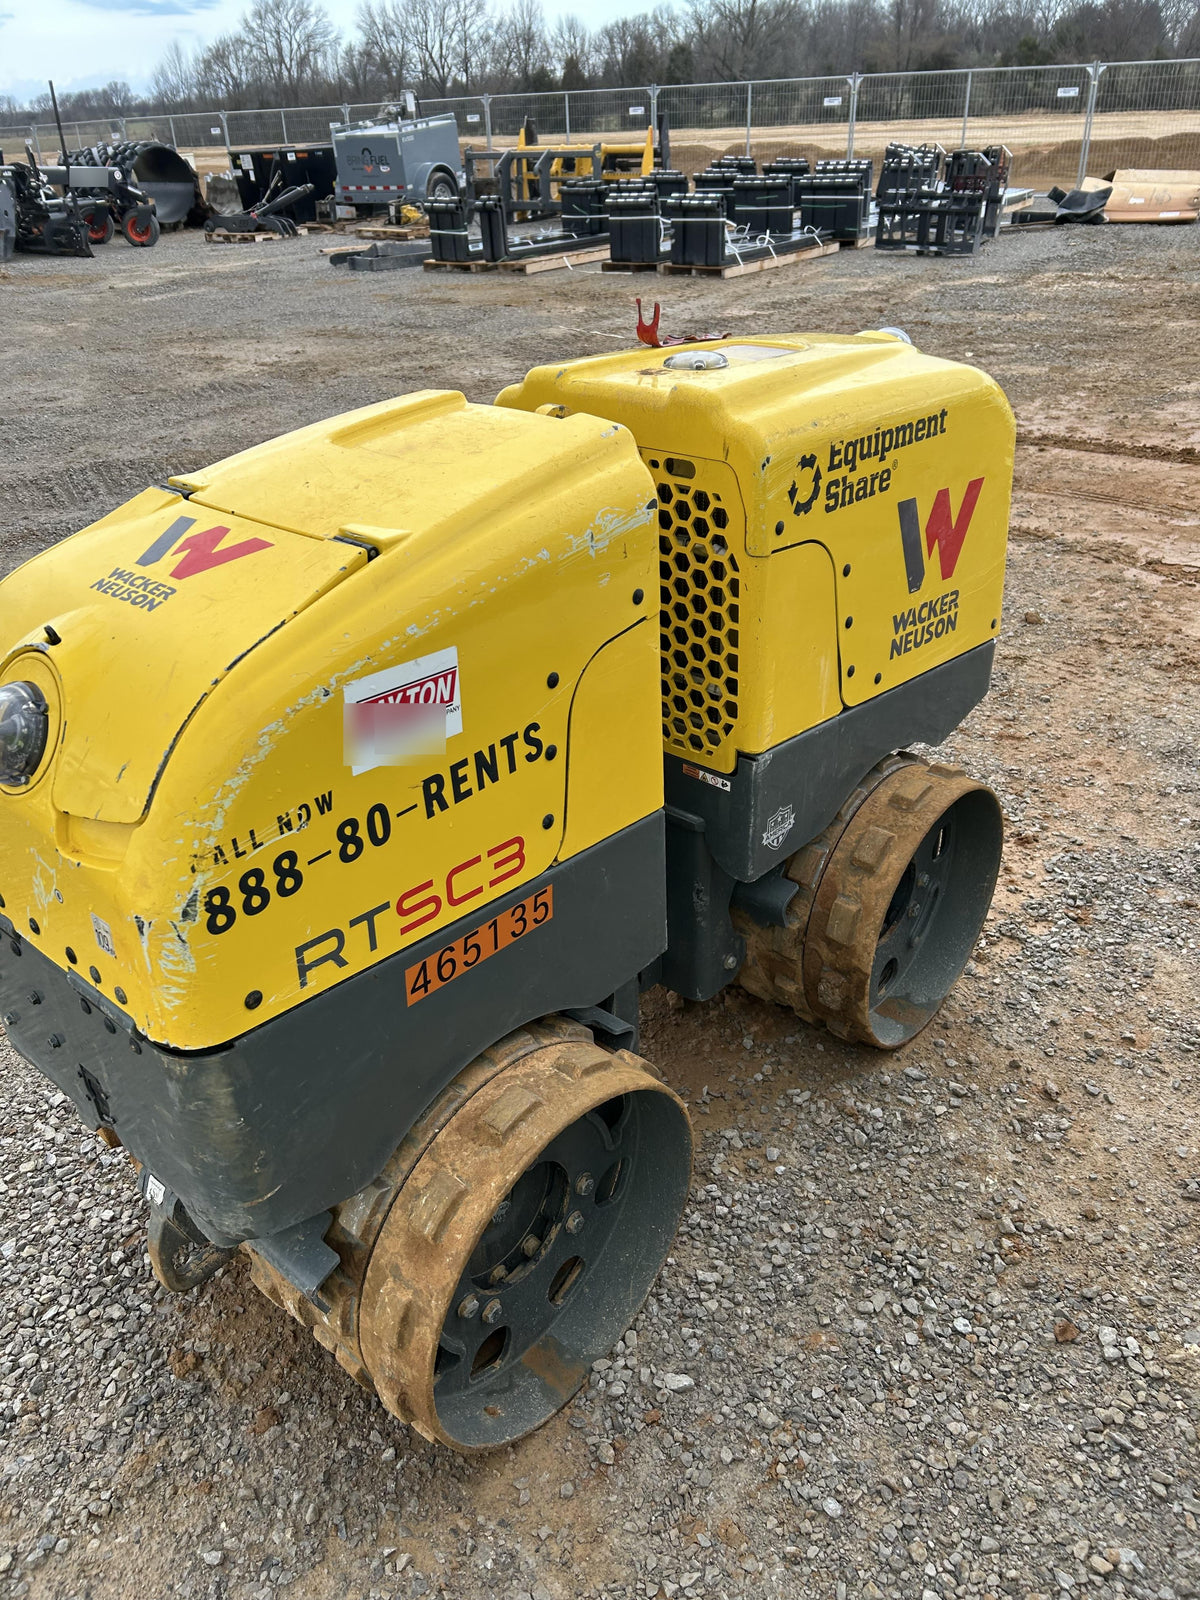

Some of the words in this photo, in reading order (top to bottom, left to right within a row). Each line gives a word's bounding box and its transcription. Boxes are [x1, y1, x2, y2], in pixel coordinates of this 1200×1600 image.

[369, 154, 391, 167] FUEL
[827, 408, 948, 473] Equipment
[90, 578, 164, 612] NEUSON
[107, 567, 177, 601] WACKER
[889, 611, 958, 661] NEUSON
[892, 589, 960, 636] WACKER
[189, 829, 263, 874] ALL
[294, 835, 526, 990] RTSC3
[410, 889, 549, 995] 465135
